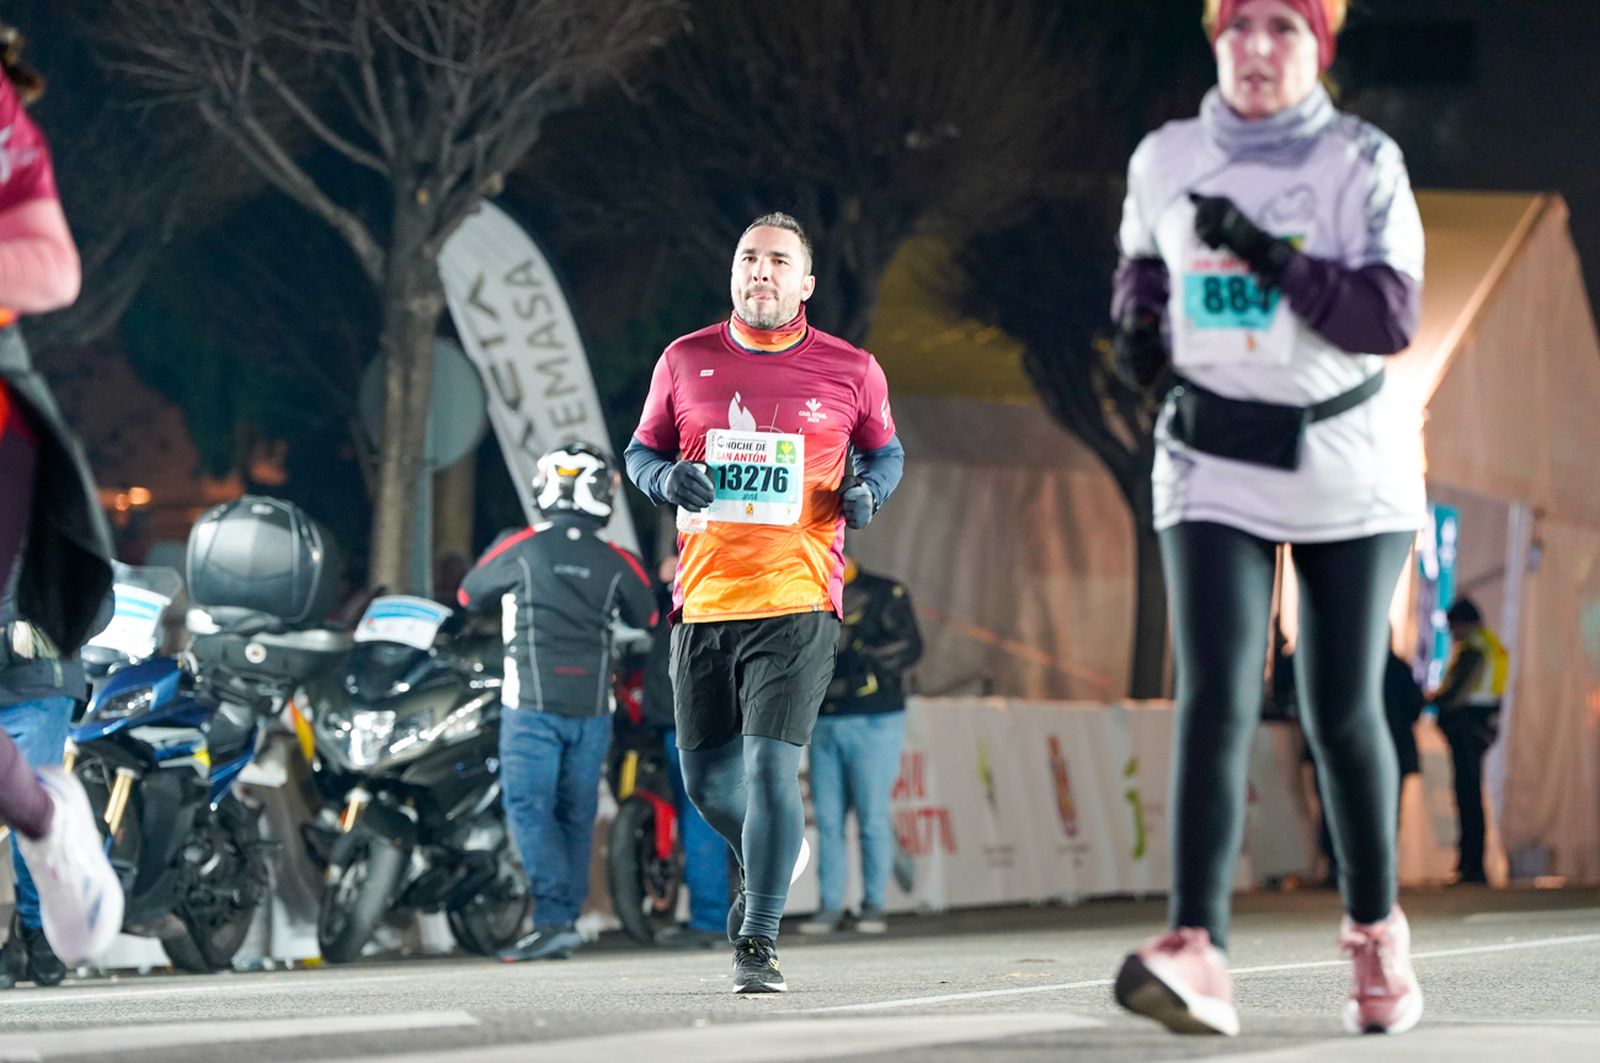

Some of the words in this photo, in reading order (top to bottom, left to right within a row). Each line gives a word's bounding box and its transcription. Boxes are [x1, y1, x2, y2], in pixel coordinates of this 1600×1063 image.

[726, 441, 754, 451] NOCHE
[755, 442, 767, 451] DE
[716, 451, 732, 461] SAN
[733, 450, 767, 463] ANTÓN
[718, 463, 789, 493] 13276
